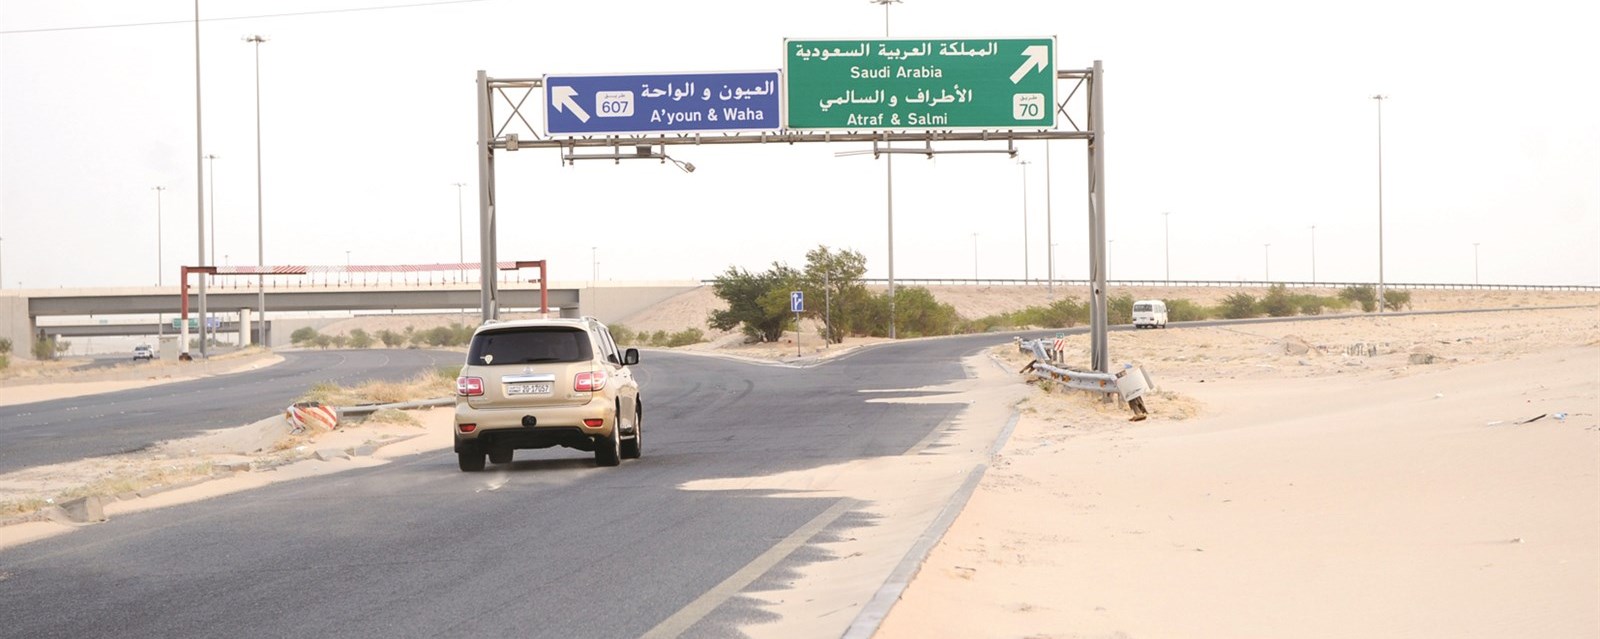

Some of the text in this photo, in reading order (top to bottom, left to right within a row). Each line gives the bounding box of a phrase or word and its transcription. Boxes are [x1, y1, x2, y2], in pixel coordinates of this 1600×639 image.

[795, 41, 998, 61] المملكة العربية السعودية
[850, 65, 943, 79] Saudi Arabia
[641, 80, 775, 102] العيون و الواحة
[819, 83, 973, 112] الأطراف و السالمي
[602, 100, 629, 114] 607
[1019, 103, 1039, 117] 70
[707, 108, 718, 122] &
[723, 107, 764, 121] Waha
[847, 112, 948, 126] Atraf & Salmi
